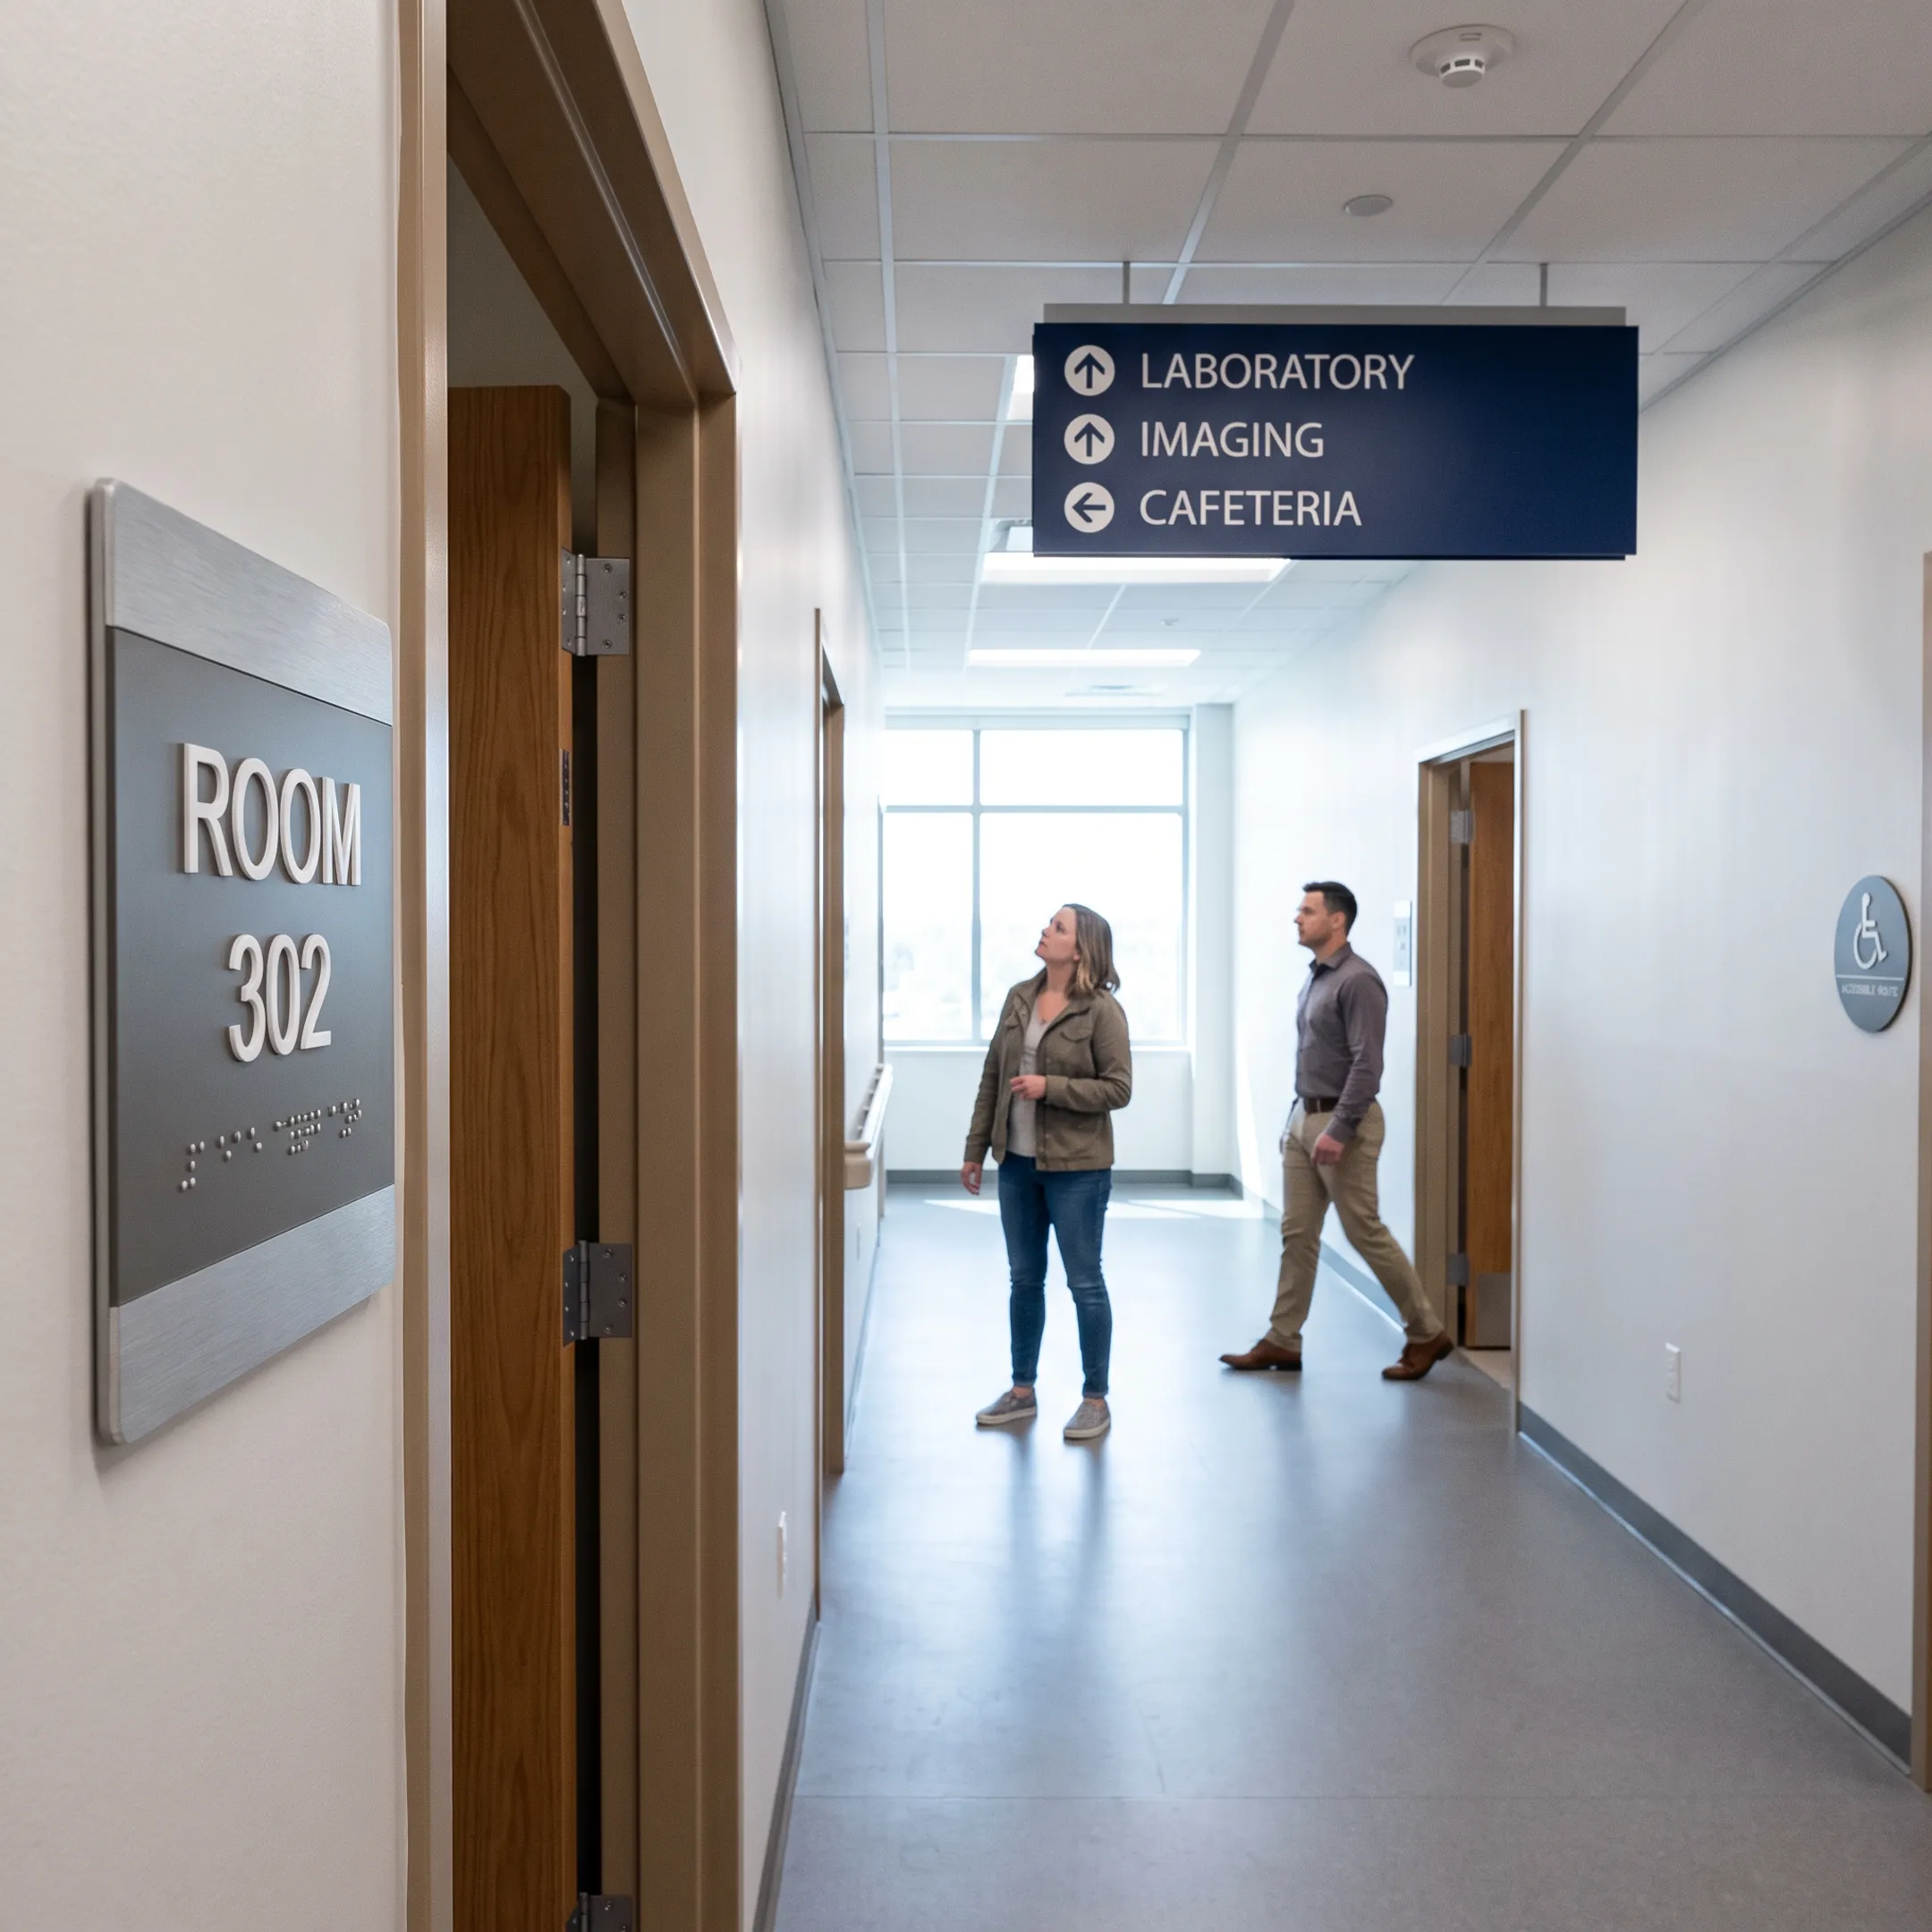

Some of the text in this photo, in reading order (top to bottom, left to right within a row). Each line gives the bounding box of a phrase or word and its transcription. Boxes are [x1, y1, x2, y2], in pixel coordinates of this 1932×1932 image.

[1142, 353, 1413, 390] LABORATORY
[1141, 421, 1324, 458] IMAGING
[1140, 489, 1362, 527] CAFETERIA
[182, 742, 361, 886] ROOM
[228, 933, 332, 1063] 302
